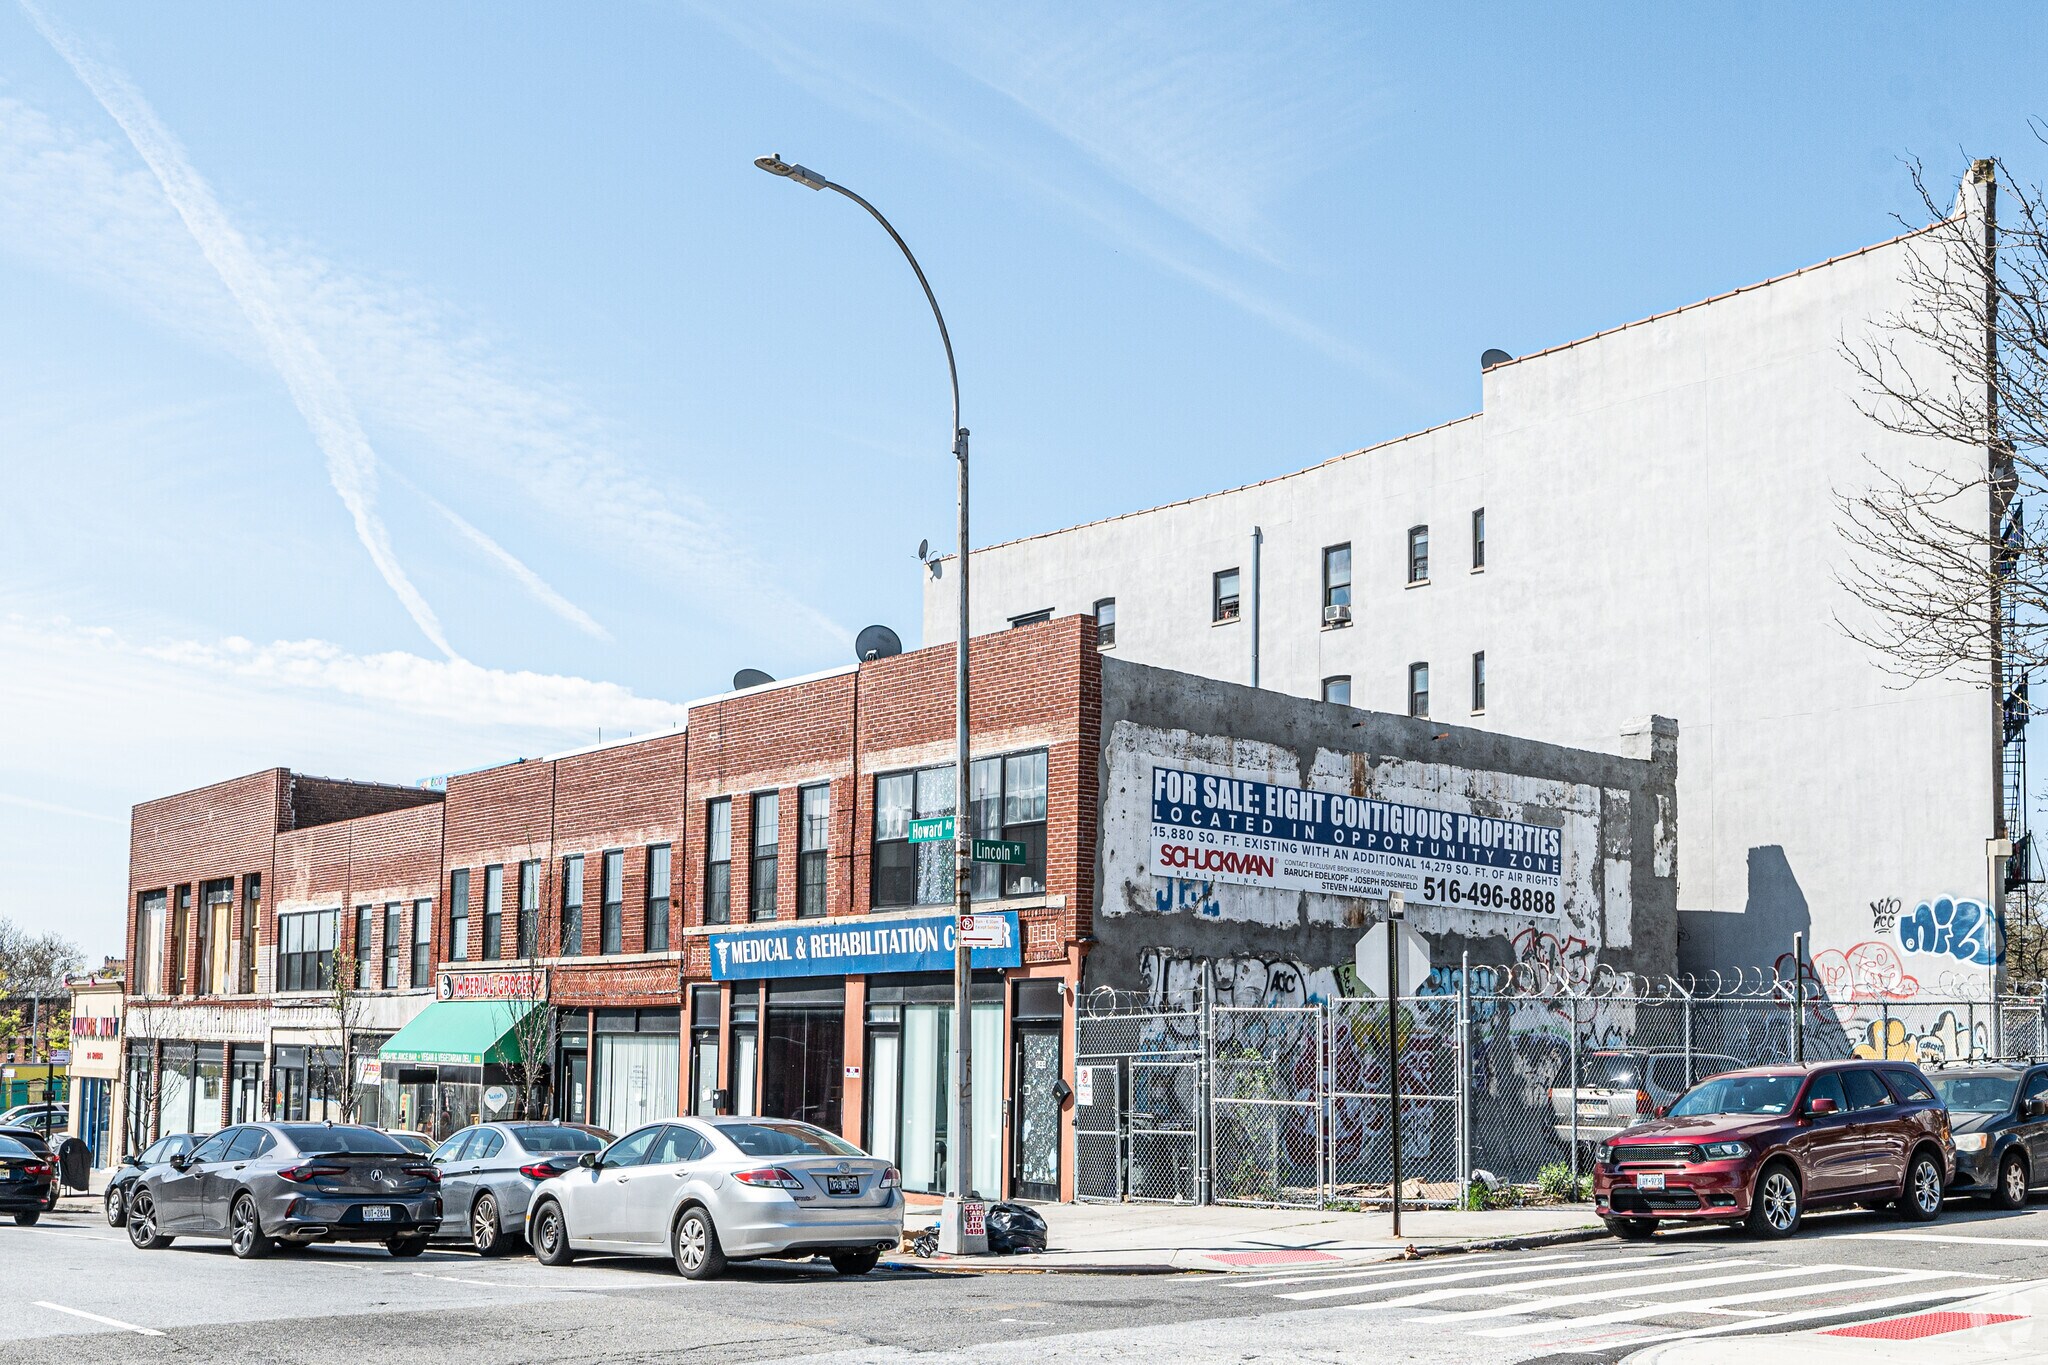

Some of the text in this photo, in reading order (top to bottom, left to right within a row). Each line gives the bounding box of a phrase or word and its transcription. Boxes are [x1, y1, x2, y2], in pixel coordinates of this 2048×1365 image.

[1154, 769, 1559, 857] FOR SALE: EIGHT CONTIGUOUS PROPERTIES
[912, 820, 942, 839] Howard
[1154, 804, 1559, 873] LOCATED IN OPPORTUNITY ZONE
[976, 842, 1010, 860] Lincoln
[1152, 826, 1559, 887] 15,880 SQ. FT. EXISTING WITH AN ADDITIONAL 14,279 SQ. FT. OF AIR RIGHTS
[1160, 844, 1274, 877] SCHUCKMAN
[1176, 870, 1260, 885] REALTY INC.
[1284, 859, 1418, 880] CONTACT EXCLUSIVE BROKERS FOR MORE INFORMATION
[1284, 868, 1418, 890] BARUCH EDELKOPF JOSEPH ROSENFELD
[1321, 881, 1383, 895] STEVEN HAKAKIAN
[1423, 876, 1556, 914] 516-496-8888
[730, 937, 792, 964] MEDICAL
[796, 935, 806, 959] &
[810, 926, 938, 959] REHABILITATION
[453, 974, 494, 996] IMPERIAL
[72, 1017, 117, 1037] LAUNDROMAT
[421, 1053, 435, 1062] VEGAN
[438, 1053, 463, 1063] VEGETARIAN
[463, 1054, 472, 1063] DELI
